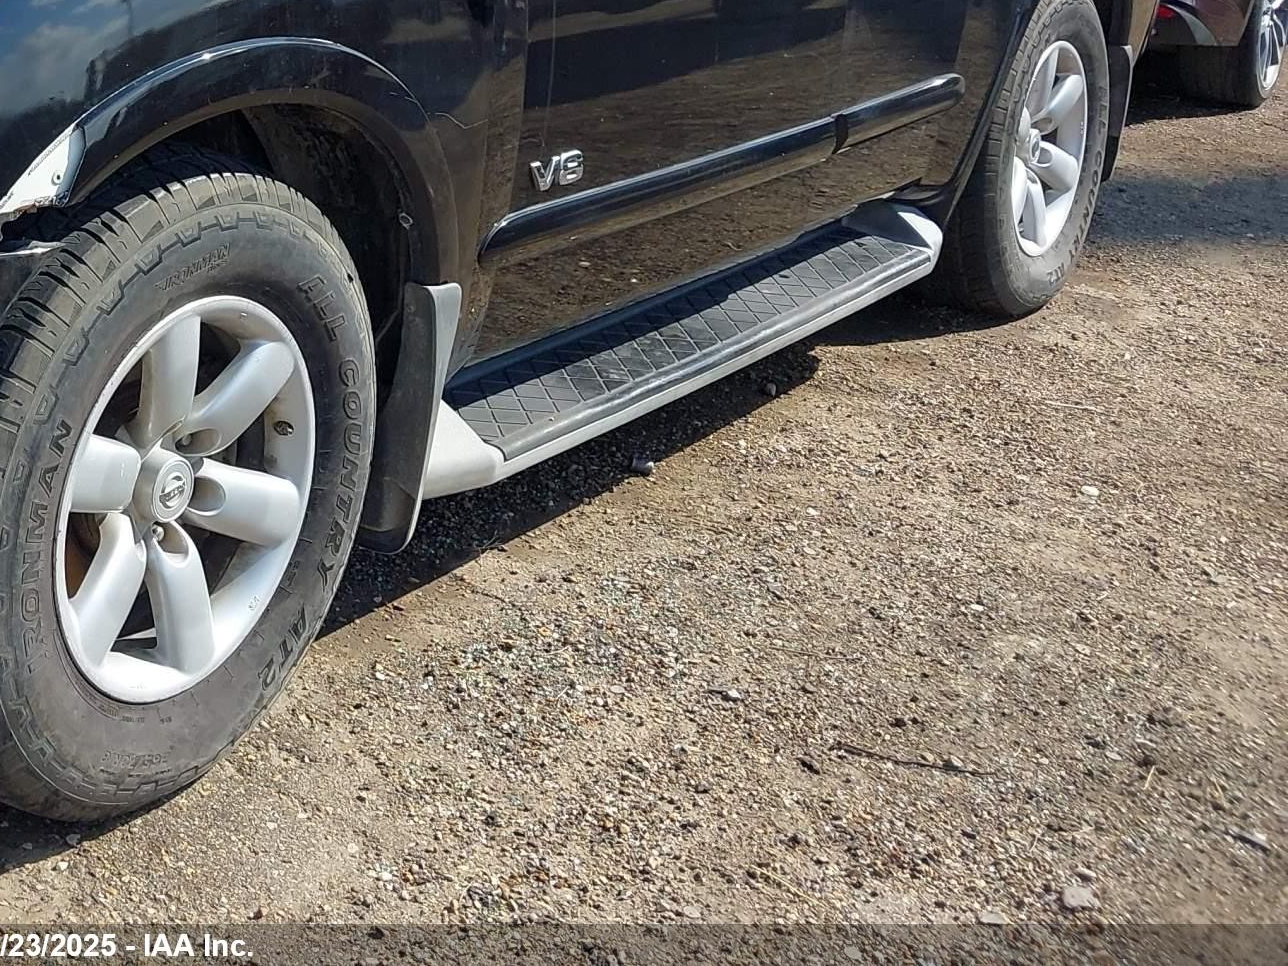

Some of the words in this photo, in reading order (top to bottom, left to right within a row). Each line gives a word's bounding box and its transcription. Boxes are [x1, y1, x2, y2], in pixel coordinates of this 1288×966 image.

[298, 273, 348, 342] ALL
[20, 418, 74, 676] IRONMAN
[316, 356, 363, 592] COUNTRY
[257, 601, 308, 692] AT2
